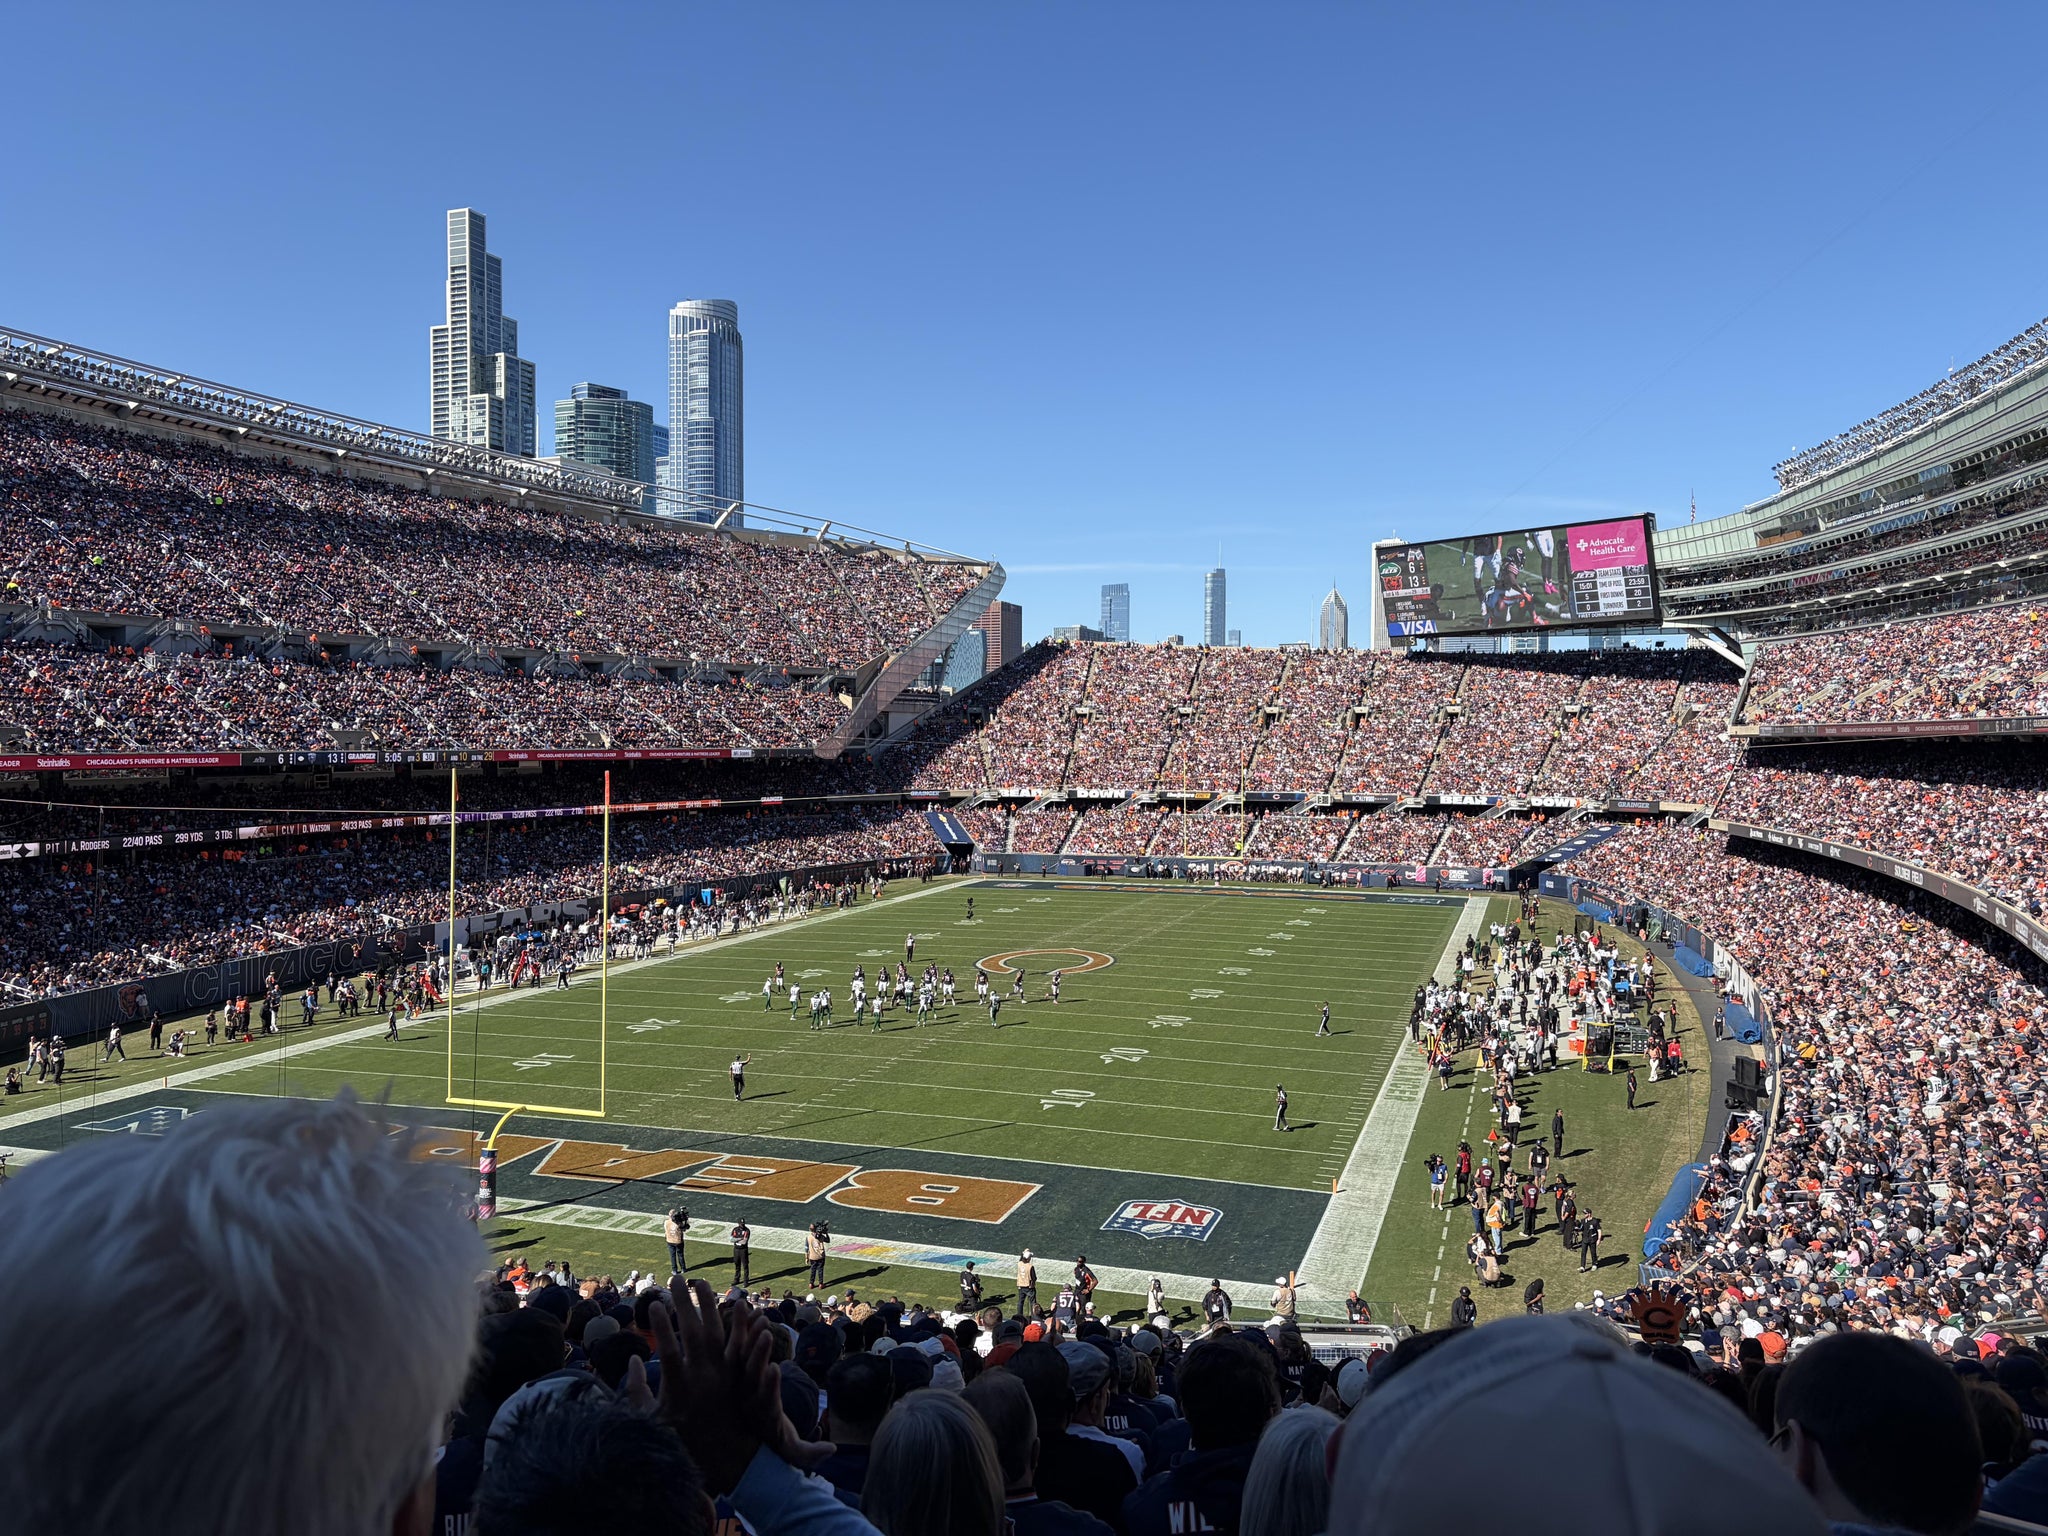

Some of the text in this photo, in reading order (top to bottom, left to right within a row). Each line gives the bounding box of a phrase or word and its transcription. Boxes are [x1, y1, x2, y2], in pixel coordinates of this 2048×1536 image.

[1589, 537, 1625, 547] Advocate
[1590, 544, 1636, 556] Health Care
[1380, 567, 1398, 575] JETS
[1408, 562, 1416, 573] 6
[1598, 568, 1622, 577] TEAM STATS
[1408, 576, 1420, 588] 13
[1574, 572, 1596, 580] JETS
[1628, 578, 1645, 586] 23:59
[1602, 602, 1624, 610] TURNOVERS
[1400, 620, 1434, 636] VISA
[37, 758, 71, 768] Steinhafels
[278, 754, 284, 764] 6
[328, 753, 338, 764] 13
[384, 752, 402, 762] 5:05
[416, 752, 420, 762] 3
[442, 752, 446, 761] 1
[460, 752, 468, 761] 10
[484, 752, 492, 762] 29
[1000, 788, 1042, 798] BEAR
[1076, 790, 1126, 798] DOWN
[1440, 796, 1488, 805] BEAR
[1530, 799, 1578, 807] DOWN
[525, 810, 537, 818] PASS
[282, 826, 294, 835] CLV
[302, 825, 308, 834] D.
[310, 824, 331, 832] WATSON
[341, 821, 358, 831] 24/33
[358, 820, 372, 830] PASS
[394, 818, 404, 826] YDS
[46, 842, 60, 854] PIT
[71, 842, 78, 852] A.
[80, 840, 110, 850] RODGERS
[122, 836, 144, 848] 22/40
[145, 834, 162, 846] PASS
[174, 833, 189, 844] 299
[190, 832, 204, 842] YDS
[214, 832, 220, 840] 3
[1894, 864, 1924, 886] SOLDIER FIELD
[974, 948, 1117, 975] C
[185, 935, 367, 1009] CHICAGO
[1100, 1047, 1150, 1062] 20
[1934, 1083, 1941, 1093] 16
[1038, 1089, 1096, 1108] 10
[365, 1118, 1044, 1225] BEAR
[1862, 1163, 1876, 1176] 45
[497, 1200, 727, 1240] CUCIAL
[1131, 1203, 1212, 1226] NFL
[1060, 1295, 1074, 1308] 57
[1644, 1307, 1675, 1330] C
[1104, 1415, 1128, 1430] TON
